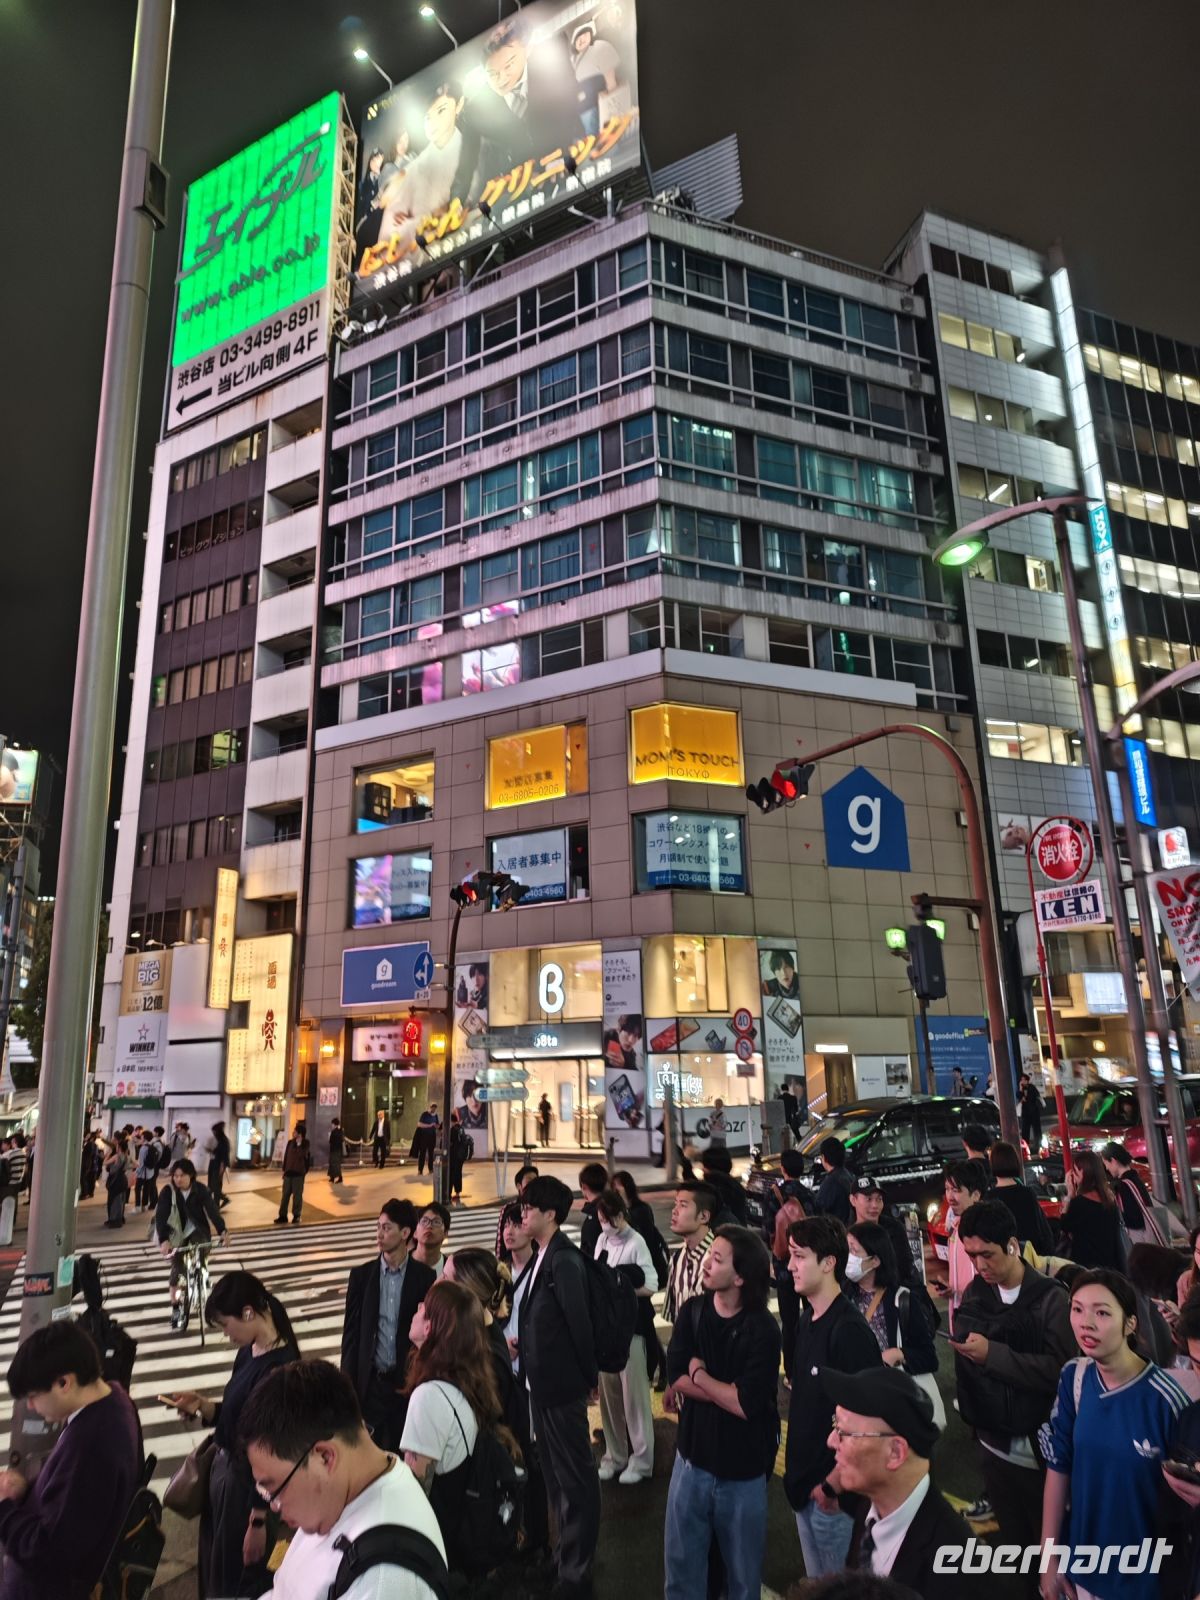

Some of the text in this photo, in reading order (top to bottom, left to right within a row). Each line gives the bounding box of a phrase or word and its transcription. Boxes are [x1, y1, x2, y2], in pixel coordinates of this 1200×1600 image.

[185, 130, 330, 272] エイブル
[181, 232, 321, 325] www.able.co.jp
[177, 299, 321, 390] 渋谷店 03-3499-8911
[217, 327, 319, 396] 当ビル向側 4F
[636, 747, 740, 768] MOM'S TOUCH
[668, 764, 711, 779] TOKYO
[847, 794, 882, 854] g
[497, 850, 562, 871] 入居者募集中
[1041, 838, 1080, 868] 消火栓
[1044, 895, 1096, 920] KEN
[137, 969, 160, 983] BIG
[138, 960, 160, 971] MEGA
[738, 1015, 749, 1027] 40
[129, 1041, 155, 1053] WINNER
